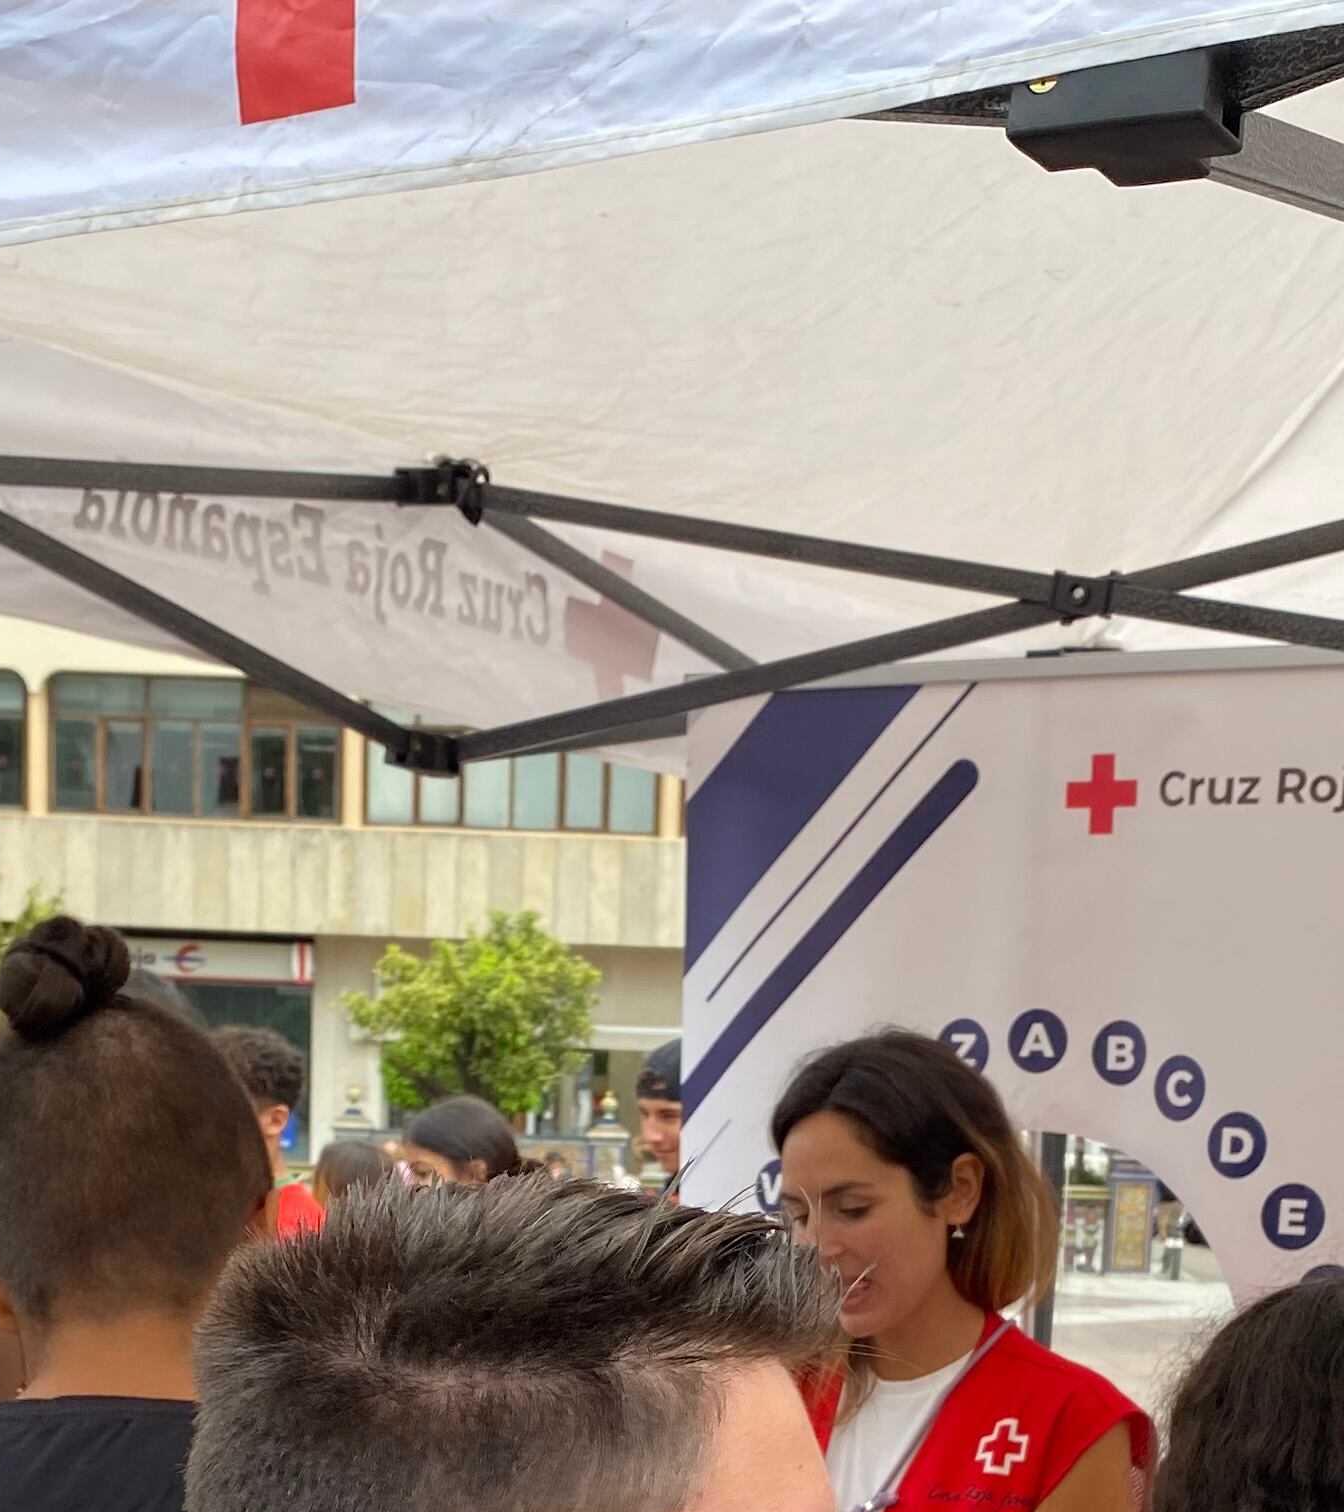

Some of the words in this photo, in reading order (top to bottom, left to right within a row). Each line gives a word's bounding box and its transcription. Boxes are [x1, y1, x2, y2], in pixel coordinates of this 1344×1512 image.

[1159, 770, 1260, 807] Cruz
[1018, 1021, 1056, 1059] A
[1106, 1035, 1136, 1071] B
[1165, 1069, 1194, 1108] C
[1219, 1126, 1255, 1164] D
[1277, 1198, 1308, 1236] E
